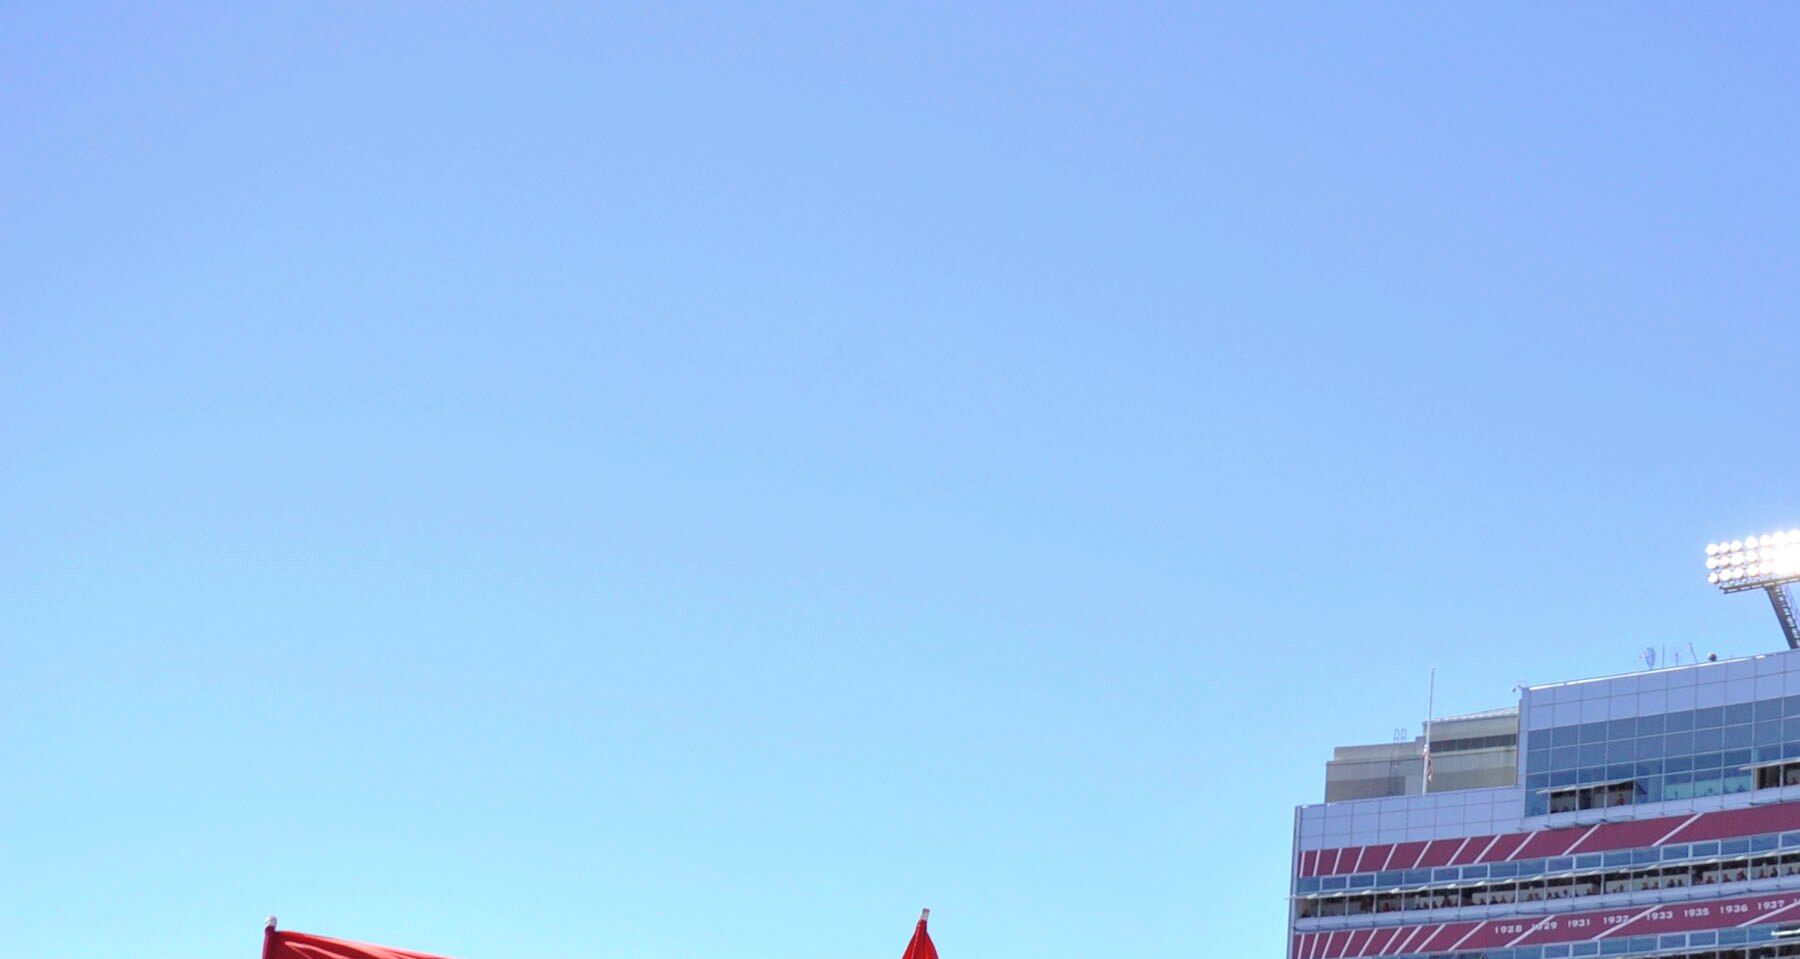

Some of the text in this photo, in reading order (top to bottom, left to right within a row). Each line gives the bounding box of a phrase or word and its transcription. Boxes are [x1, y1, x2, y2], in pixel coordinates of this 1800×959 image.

[1567, 918, 1591, 928] 1931
[1683, 907, 1710, 918] 1935
[1720, 903, 1749, 914] 1936
[1758, 899, 1785, 910] 1937
